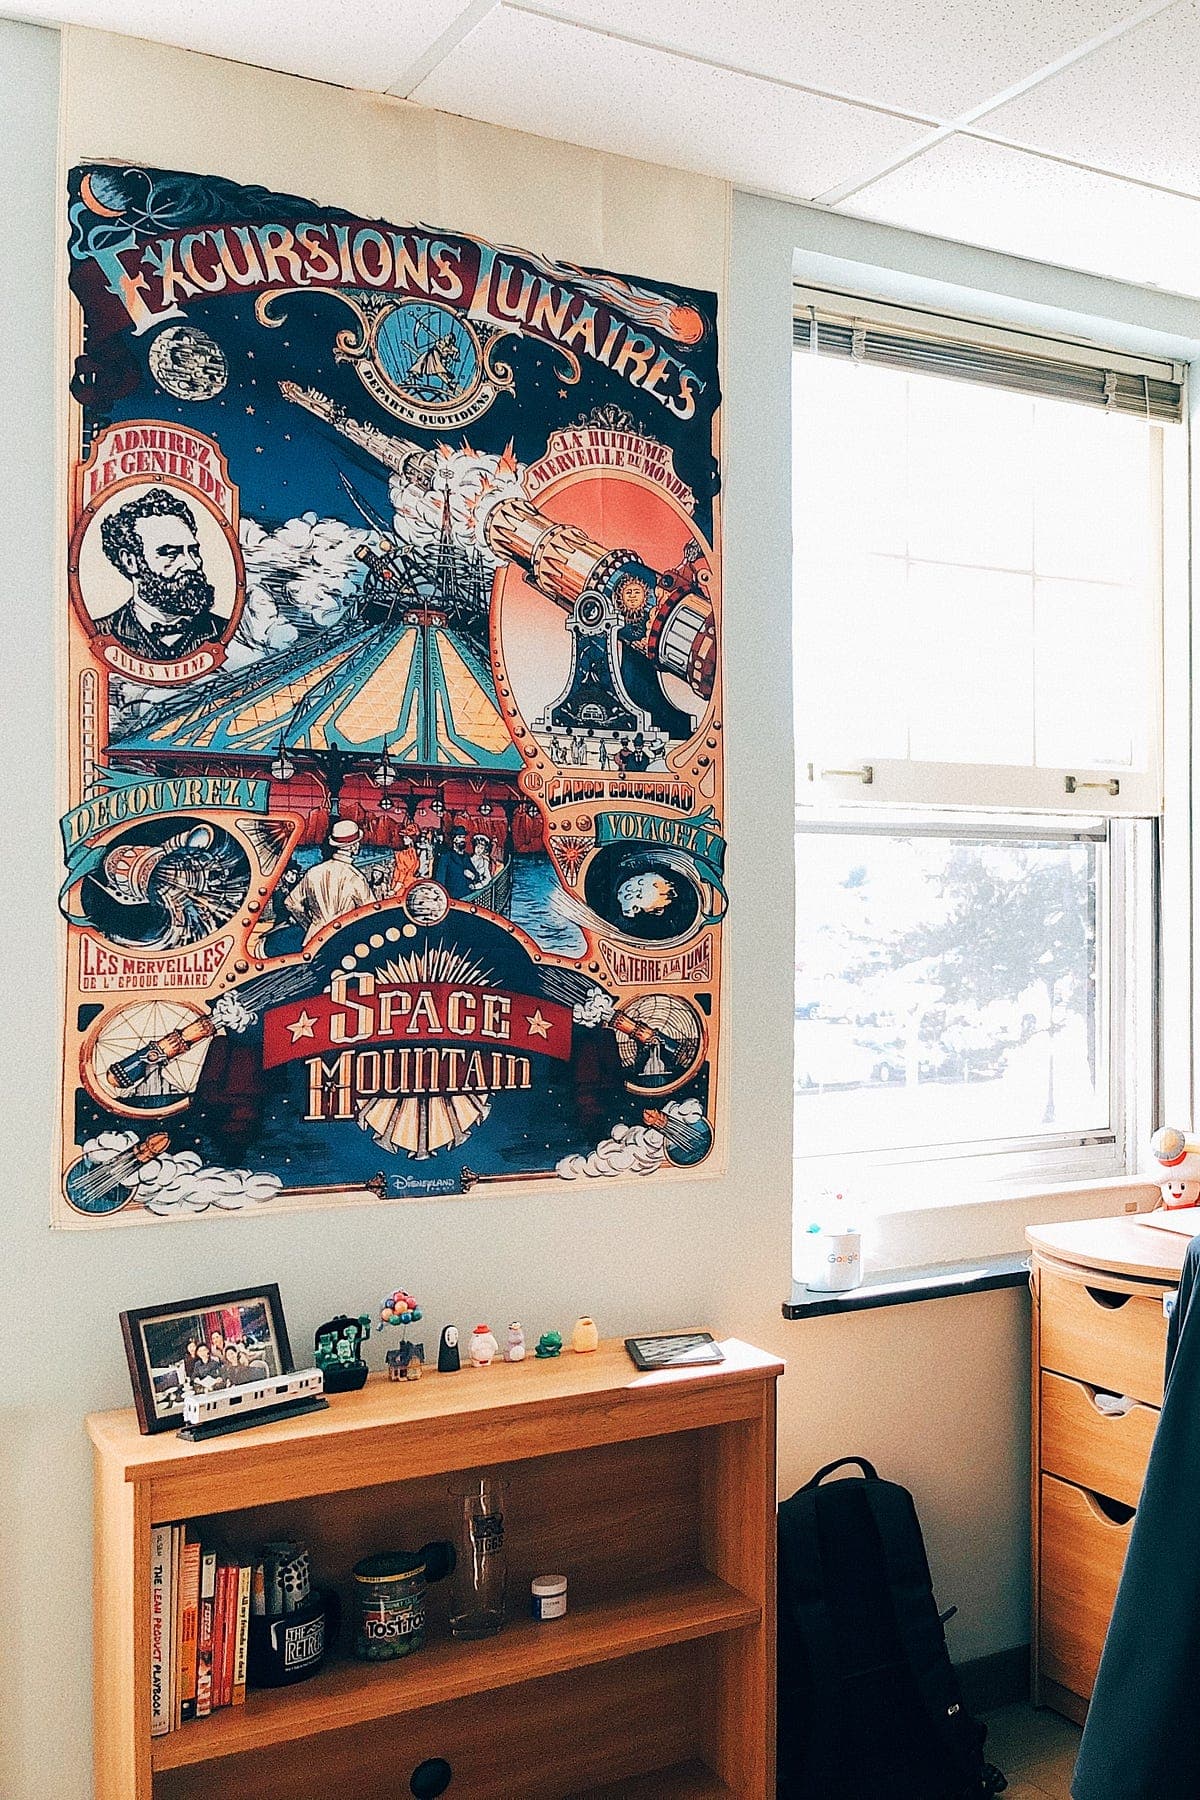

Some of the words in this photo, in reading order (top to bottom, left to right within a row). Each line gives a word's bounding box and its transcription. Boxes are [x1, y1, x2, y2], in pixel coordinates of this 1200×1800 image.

[88, 221, 464, 336] EXCURSIONS
[468, 246, 708, 420] LUNAIRES
[363, 370, 415, 419] DEPARTS
[418, 392, 490, 425] QUOTIDIENS
[110, 429, 212, 470] ADMIREZ
[553, 432, 582, 451] LA
[588, 431, 670, 465] HUITIEME
[90, 458, 118, 496] LE
[121, 450, 195, 483] GENIE
[199, 466, 227, 511] DE
[530, 448, 625, 490] MERVEILLE
[627, 454, 641, 468] DU
[641, 460, 693, 506] MONDE
[112, 650, 155, 678] JULES
[162, 654, 207, 678] VERNE
[548, 779, 605, 807] CANON
[609, 782, 694, 812] COLUMBIAD
[84, 938, 119, 976] LES
[124, 942, 226, 975] MERVEILLES
[613, 952, 628, 982] LA
[628, 958, 662, 982] TERRE
[662, 963, 669, 981] A
[670, 957, 681, 972] LA
[681, 938, 711, 980] LUNE
[83, 977, 98, 989] DE
[163, 974, 208, 987] LUNAIRE
[329, 971, 512, 1044] SPACE
[153, 1565, 163, 1585] THE
[153, 1588, 163, 1614] LEAN
[152, 1617, 163, 1662] PRODUCT
[289, 1626, 306, 1641] THE
[152, 1664, 162, 1717] PLAYBOOK
